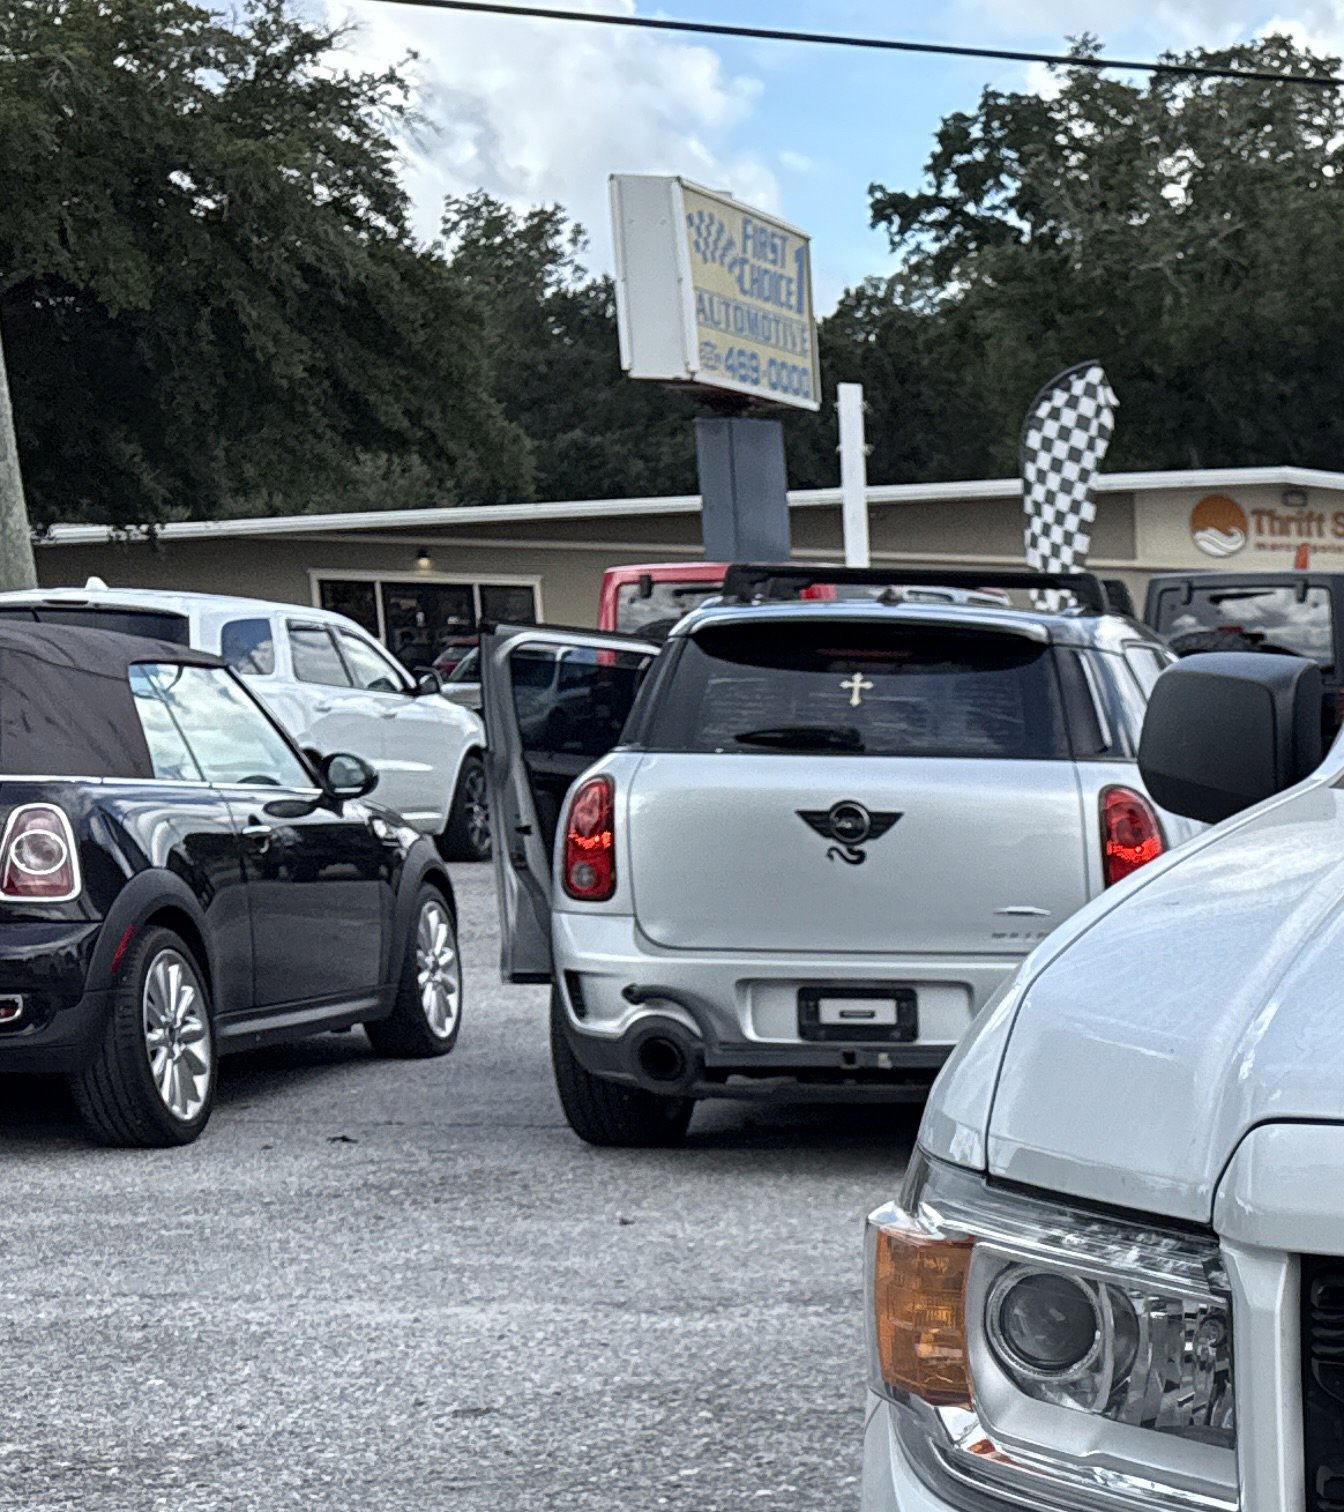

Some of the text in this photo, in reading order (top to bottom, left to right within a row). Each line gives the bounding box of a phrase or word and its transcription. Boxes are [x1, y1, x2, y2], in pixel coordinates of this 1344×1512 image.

[741, 215, 789, 269] FIRST
[727, 255, 794, 310] CHOICE
[696, 289, 809, 357] AUTOMOTIVE
[1250, 508, 1325, 538] Thrift
